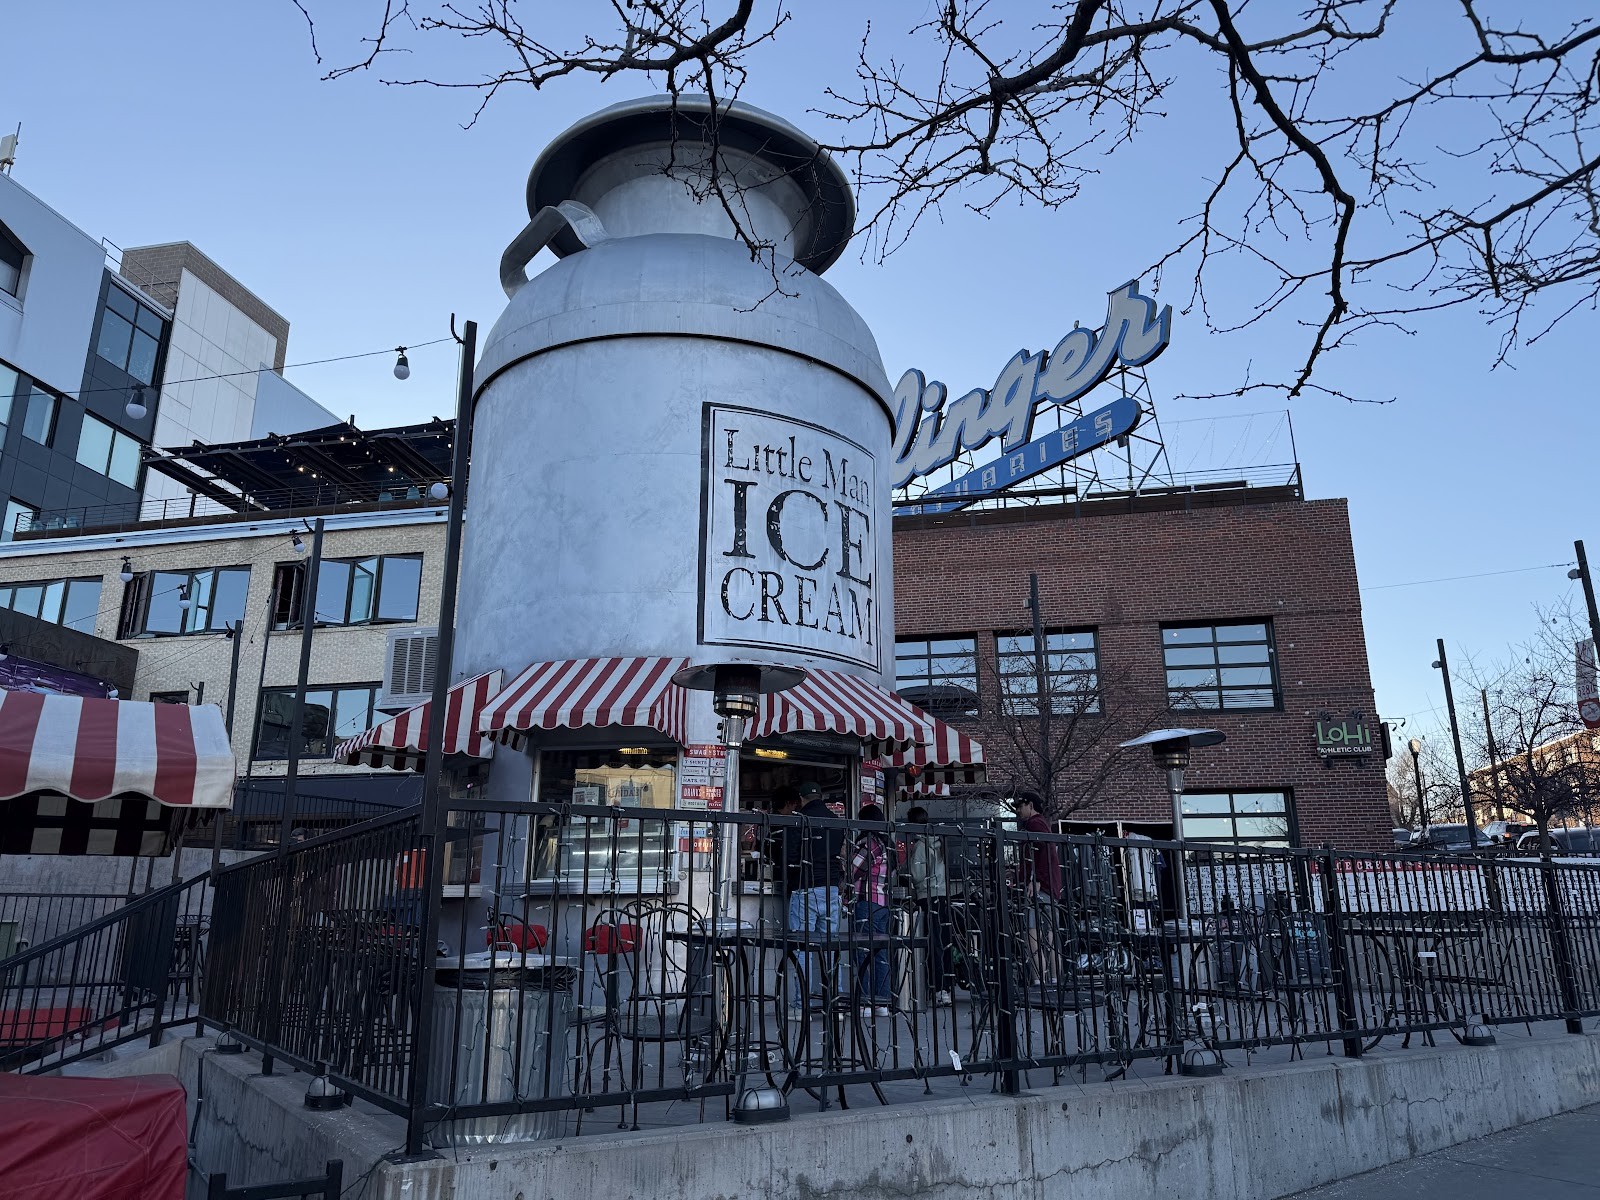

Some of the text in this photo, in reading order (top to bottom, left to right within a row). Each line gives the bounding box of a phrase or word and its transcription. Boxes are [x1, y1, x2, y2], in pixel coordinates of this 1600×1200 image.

[724, 428, 870, 507] Little Man
[723, 478, 872, 589] ICE
[720, 567, 873, 646] CREAM
[1316, 721, 1371, 745] LoHi
[1320, 746, 1352, 754] ATHLETIC
